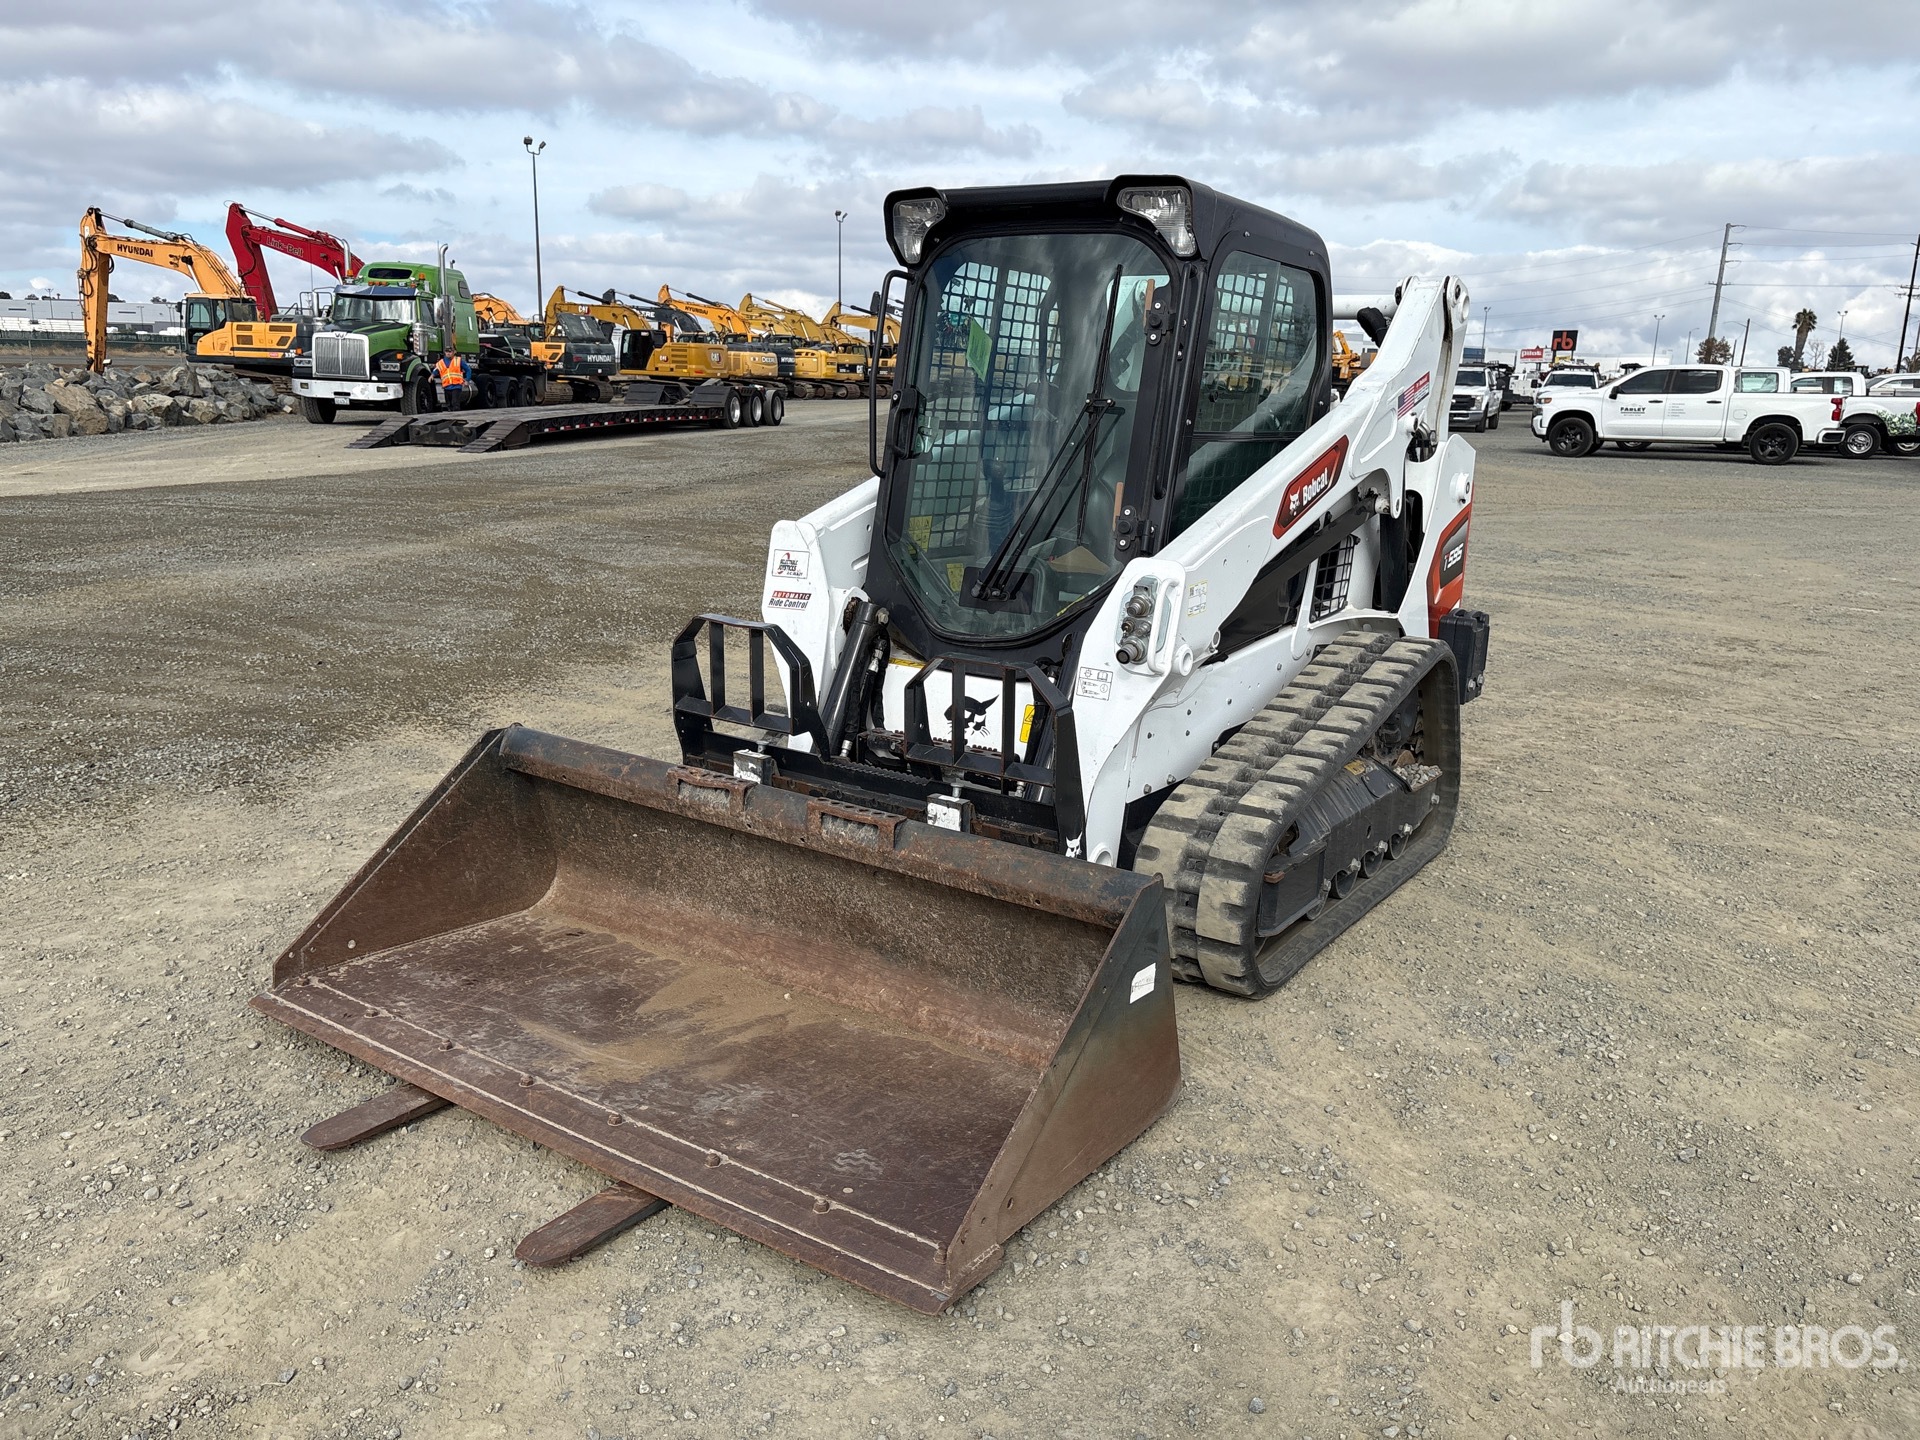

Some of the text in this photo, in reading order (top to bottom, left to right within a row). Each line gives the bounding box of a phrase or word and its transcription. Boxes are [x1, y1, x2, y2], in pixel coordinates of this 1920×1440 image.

[117, 244, 153, 258] HYUNDAI
[266, 235, 304, 258] Link-Belt
[578, 305, 589, 314] CAT
[684, 305, 708, 315] HYUNDAI
[587, 355, 612, 363] HYUNDAI
[1302, 467, 1328, 506] Bobcat
[773, 591, 811, 600] AUTOMATIC
[768, 598, 809, 609] Ride Control
